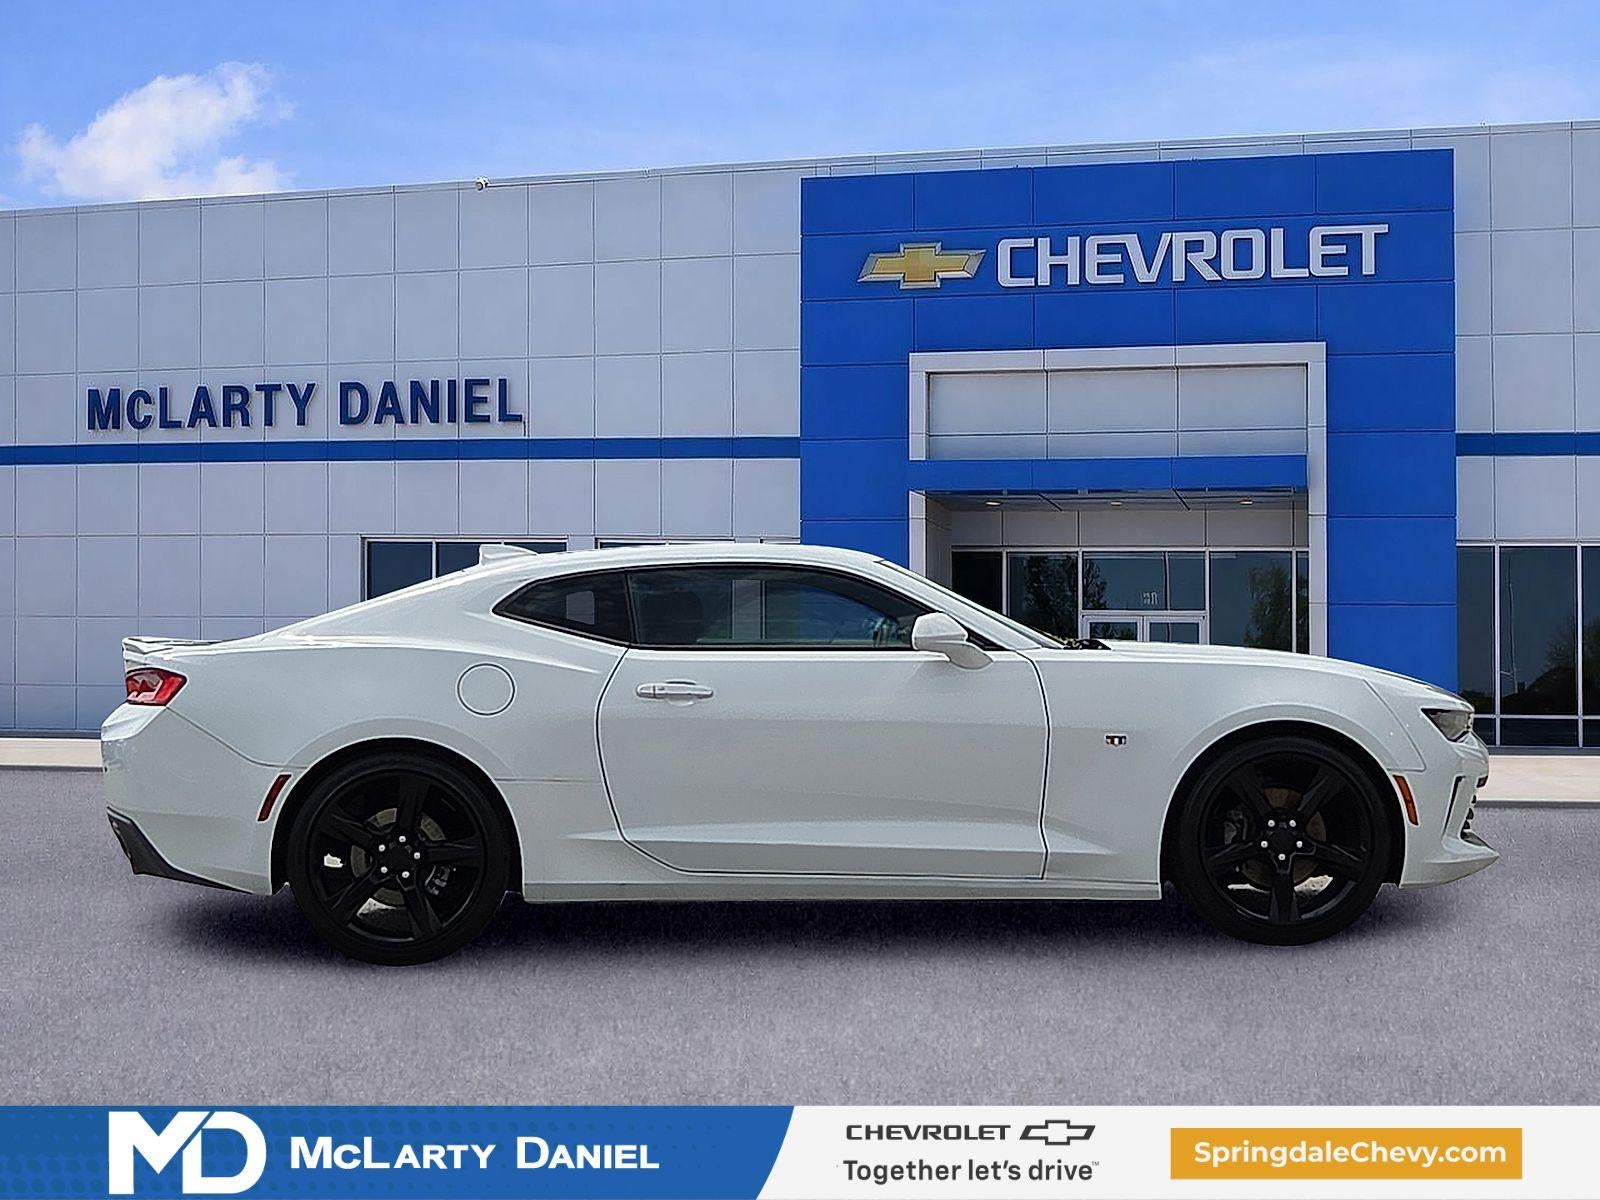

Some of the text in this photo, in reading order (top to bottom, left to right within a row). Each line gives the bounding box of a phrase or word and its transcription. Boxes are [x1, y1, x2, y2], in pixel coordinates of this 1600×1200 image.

[997, 223, 1389, 287] CHEVROLET
[87, 377, 524, 430] MCLARTY DANIEL
